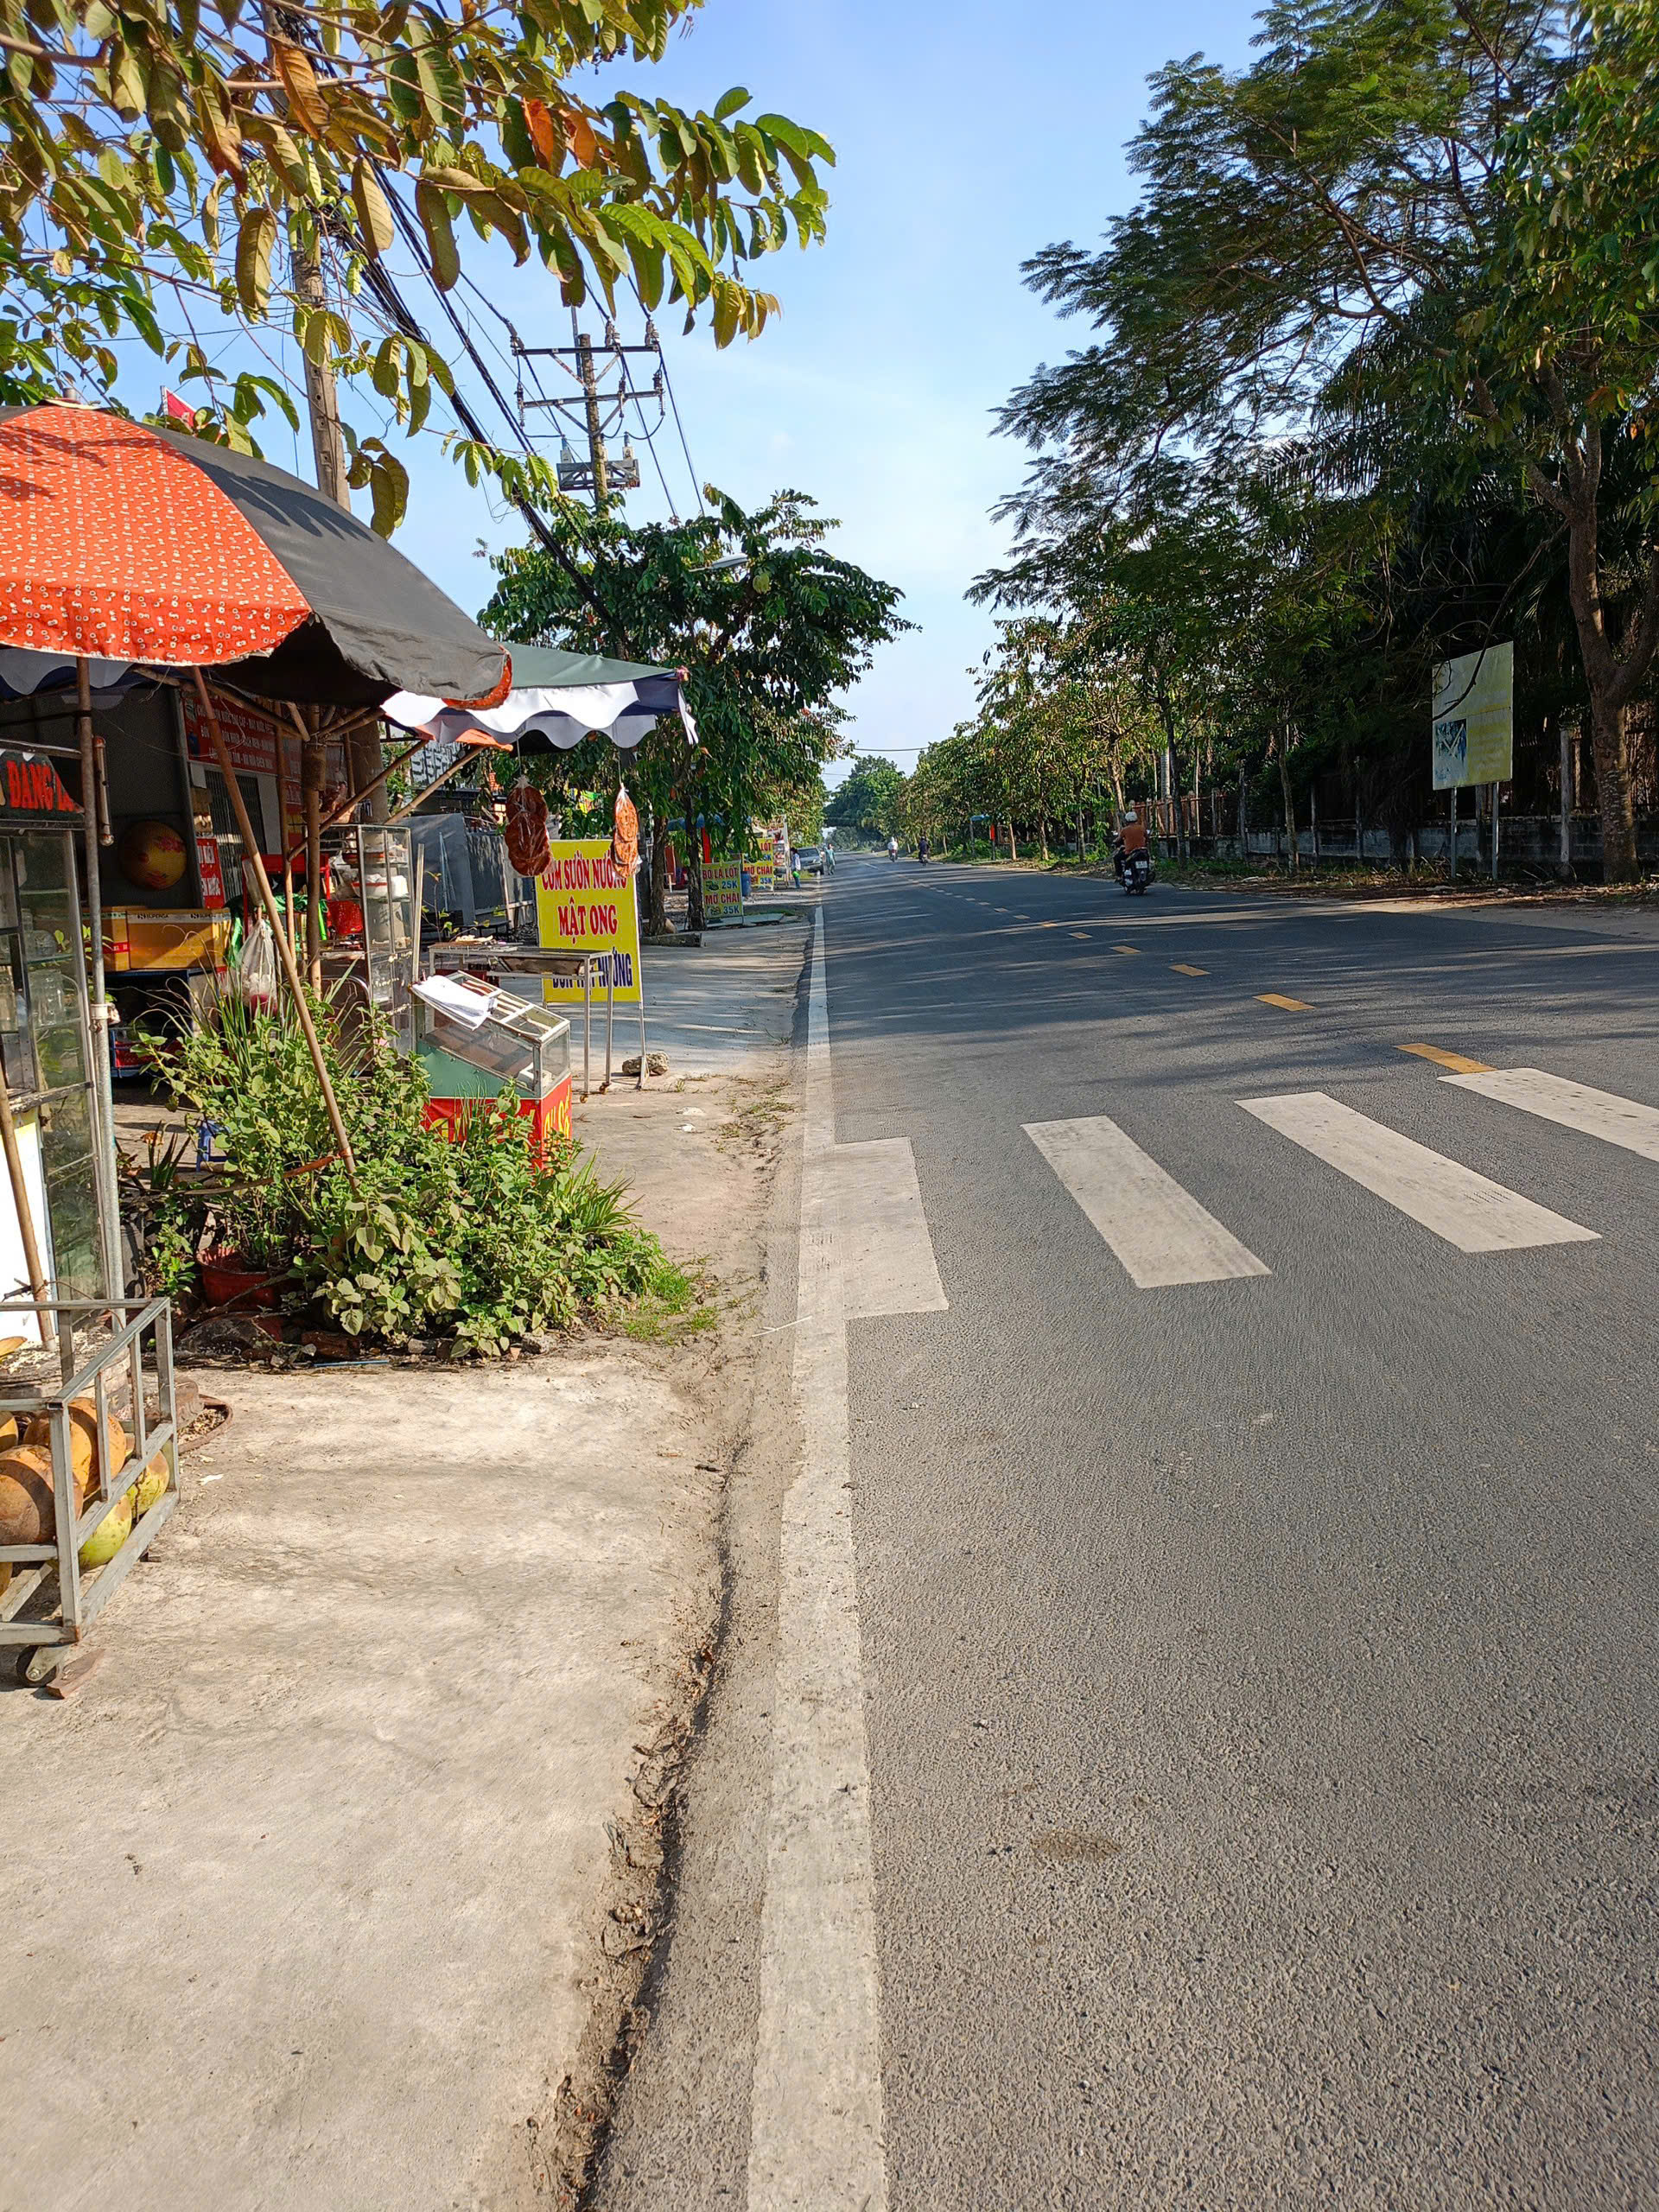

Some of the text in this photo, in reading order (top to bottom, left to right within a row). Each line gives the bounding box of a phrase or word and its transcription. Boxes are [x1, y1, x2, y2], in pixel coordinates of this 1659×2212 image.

[564, 850, 590, 891] SƯỜN
[721, 880, 738, 889] 25K
[558, 896, 618, 944] MẬT ONG
[723, 905, 740, 914] 35K
